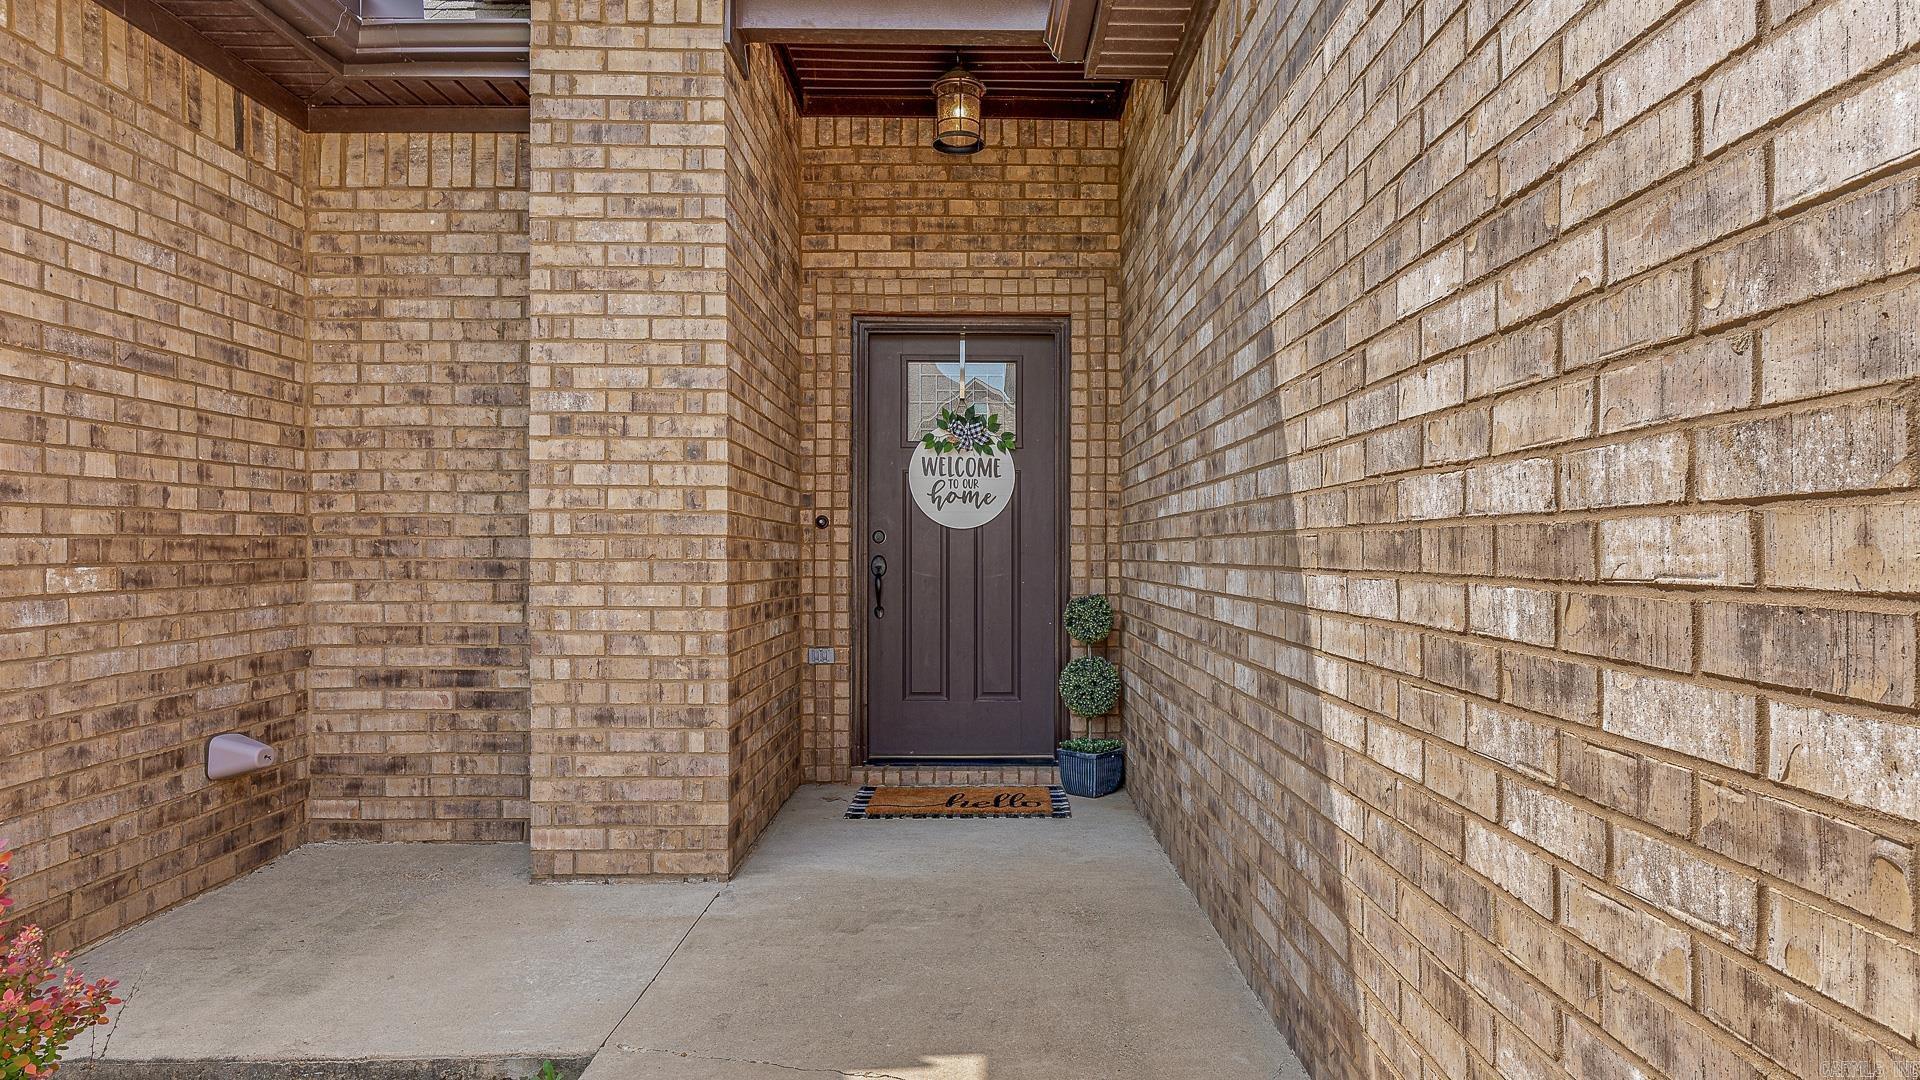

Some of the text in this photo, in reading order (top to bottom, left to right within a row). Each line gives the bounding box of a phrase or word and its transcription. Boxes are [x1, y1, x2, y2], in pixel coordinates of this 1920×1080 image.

[922, 457, 1002, 478] WELCOME
[949, 479, 979, 489] TO OUR
[927, 480, 997, 511] home
[944, 793, 1041, 808] hello
